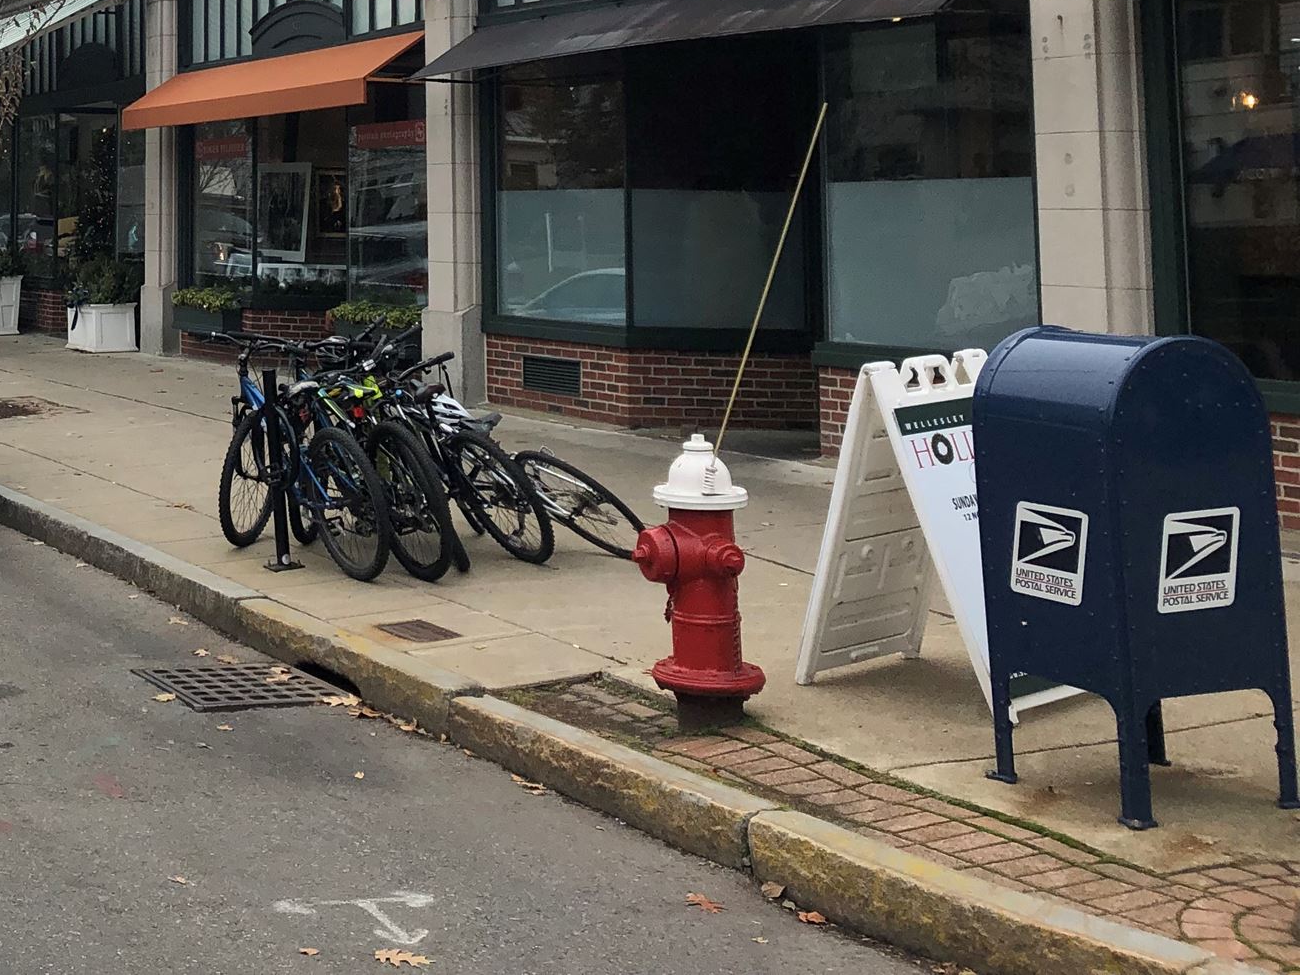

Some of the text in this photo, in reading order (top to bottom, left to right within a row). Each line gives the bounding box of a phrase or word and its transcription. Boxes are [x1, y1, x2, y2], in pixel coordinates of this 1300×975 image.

[904, 414, 965, 431] WELLESLEY
[963, 513, 972, 522] 12
[1015, 567, 1074, 588] UNITED STATES
[1015, 578, 1077, 600] POSTAL SERVICE
[1163, 579, 1227, 595] UNITED STATES
[1162, 590, 1230, 607] POSTAL SERVICE
